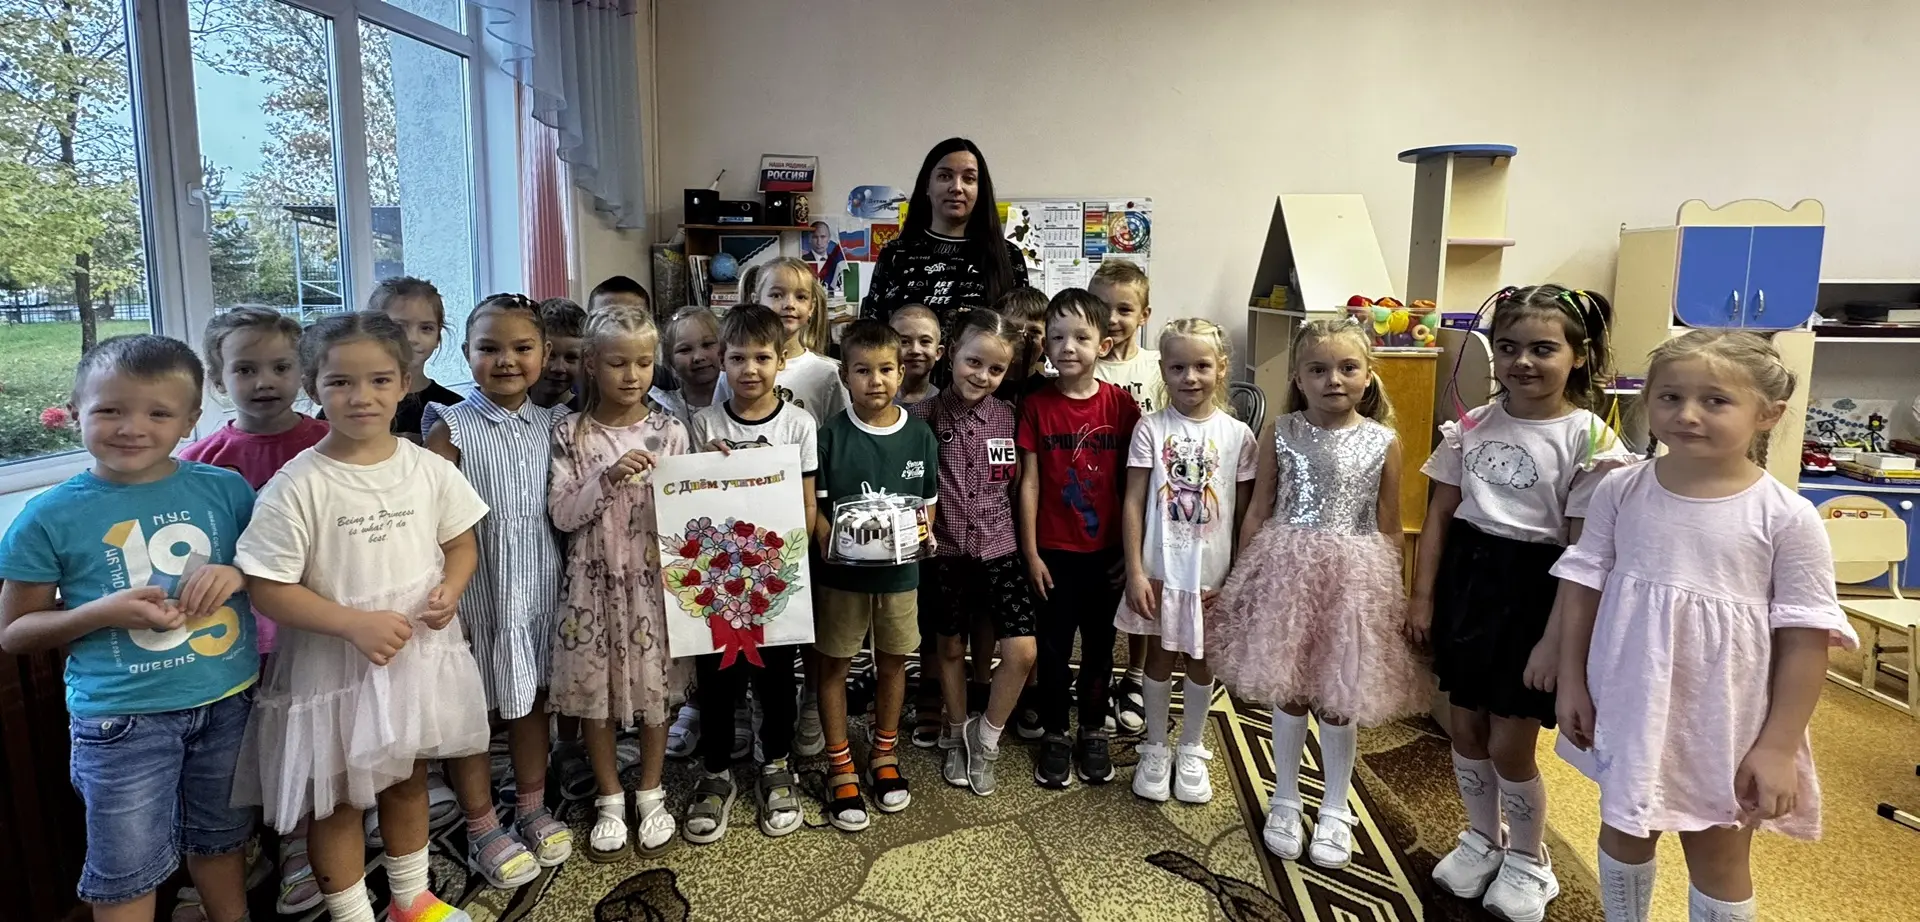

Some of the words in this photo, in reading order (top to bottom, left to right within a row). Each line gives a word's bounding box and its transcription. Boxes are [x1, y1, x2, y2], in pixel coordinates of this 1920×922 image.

[767, 170, 808, 180] РОССИЯ!
[934, 280, 955, 288] ARE
[923, 296, 952, 306] FREE
[989, 447, 1015, 462] WE
[991, 465, 1012, 480] EK
[663, 482, 676, 495] С
[679, 479, 719, 495] Днём
[721, 470, 786, 491] учителя!
[336, 516, 365, 526] Being
[378, 509, 414, 520] Princess
[348, 528, 357, 536] is
[361, 522, 384, 533] what
[386, 520, 393, 529] I
[396, 520, 406, 528] do
[368, 534, 388, 543] best.
[128, 653, 197, 674] QUEENS
